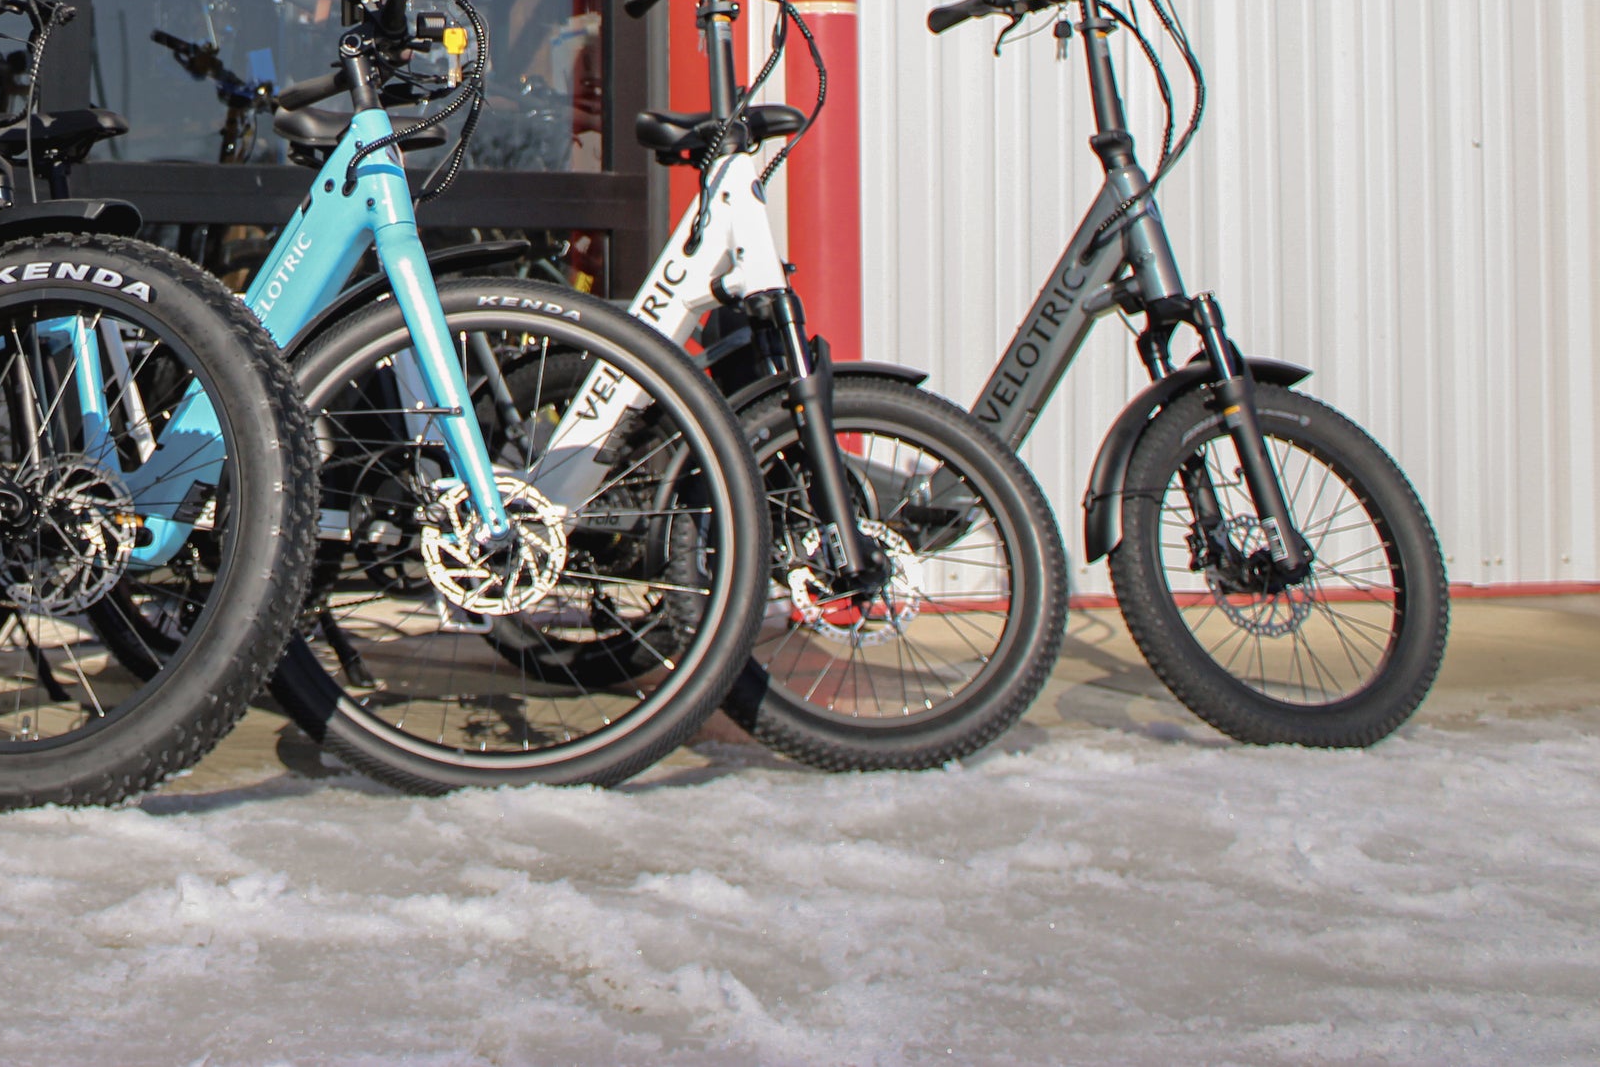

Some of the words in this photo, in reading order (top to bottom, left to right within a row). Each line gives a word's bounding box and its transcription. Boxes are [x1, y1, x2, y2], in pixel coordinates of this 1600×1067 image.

[253, 231, 312, 322] ELOTRIC
[477, 295, 581, 322] KENDA
[977, 266, 1086, 425] VELOTRIC
